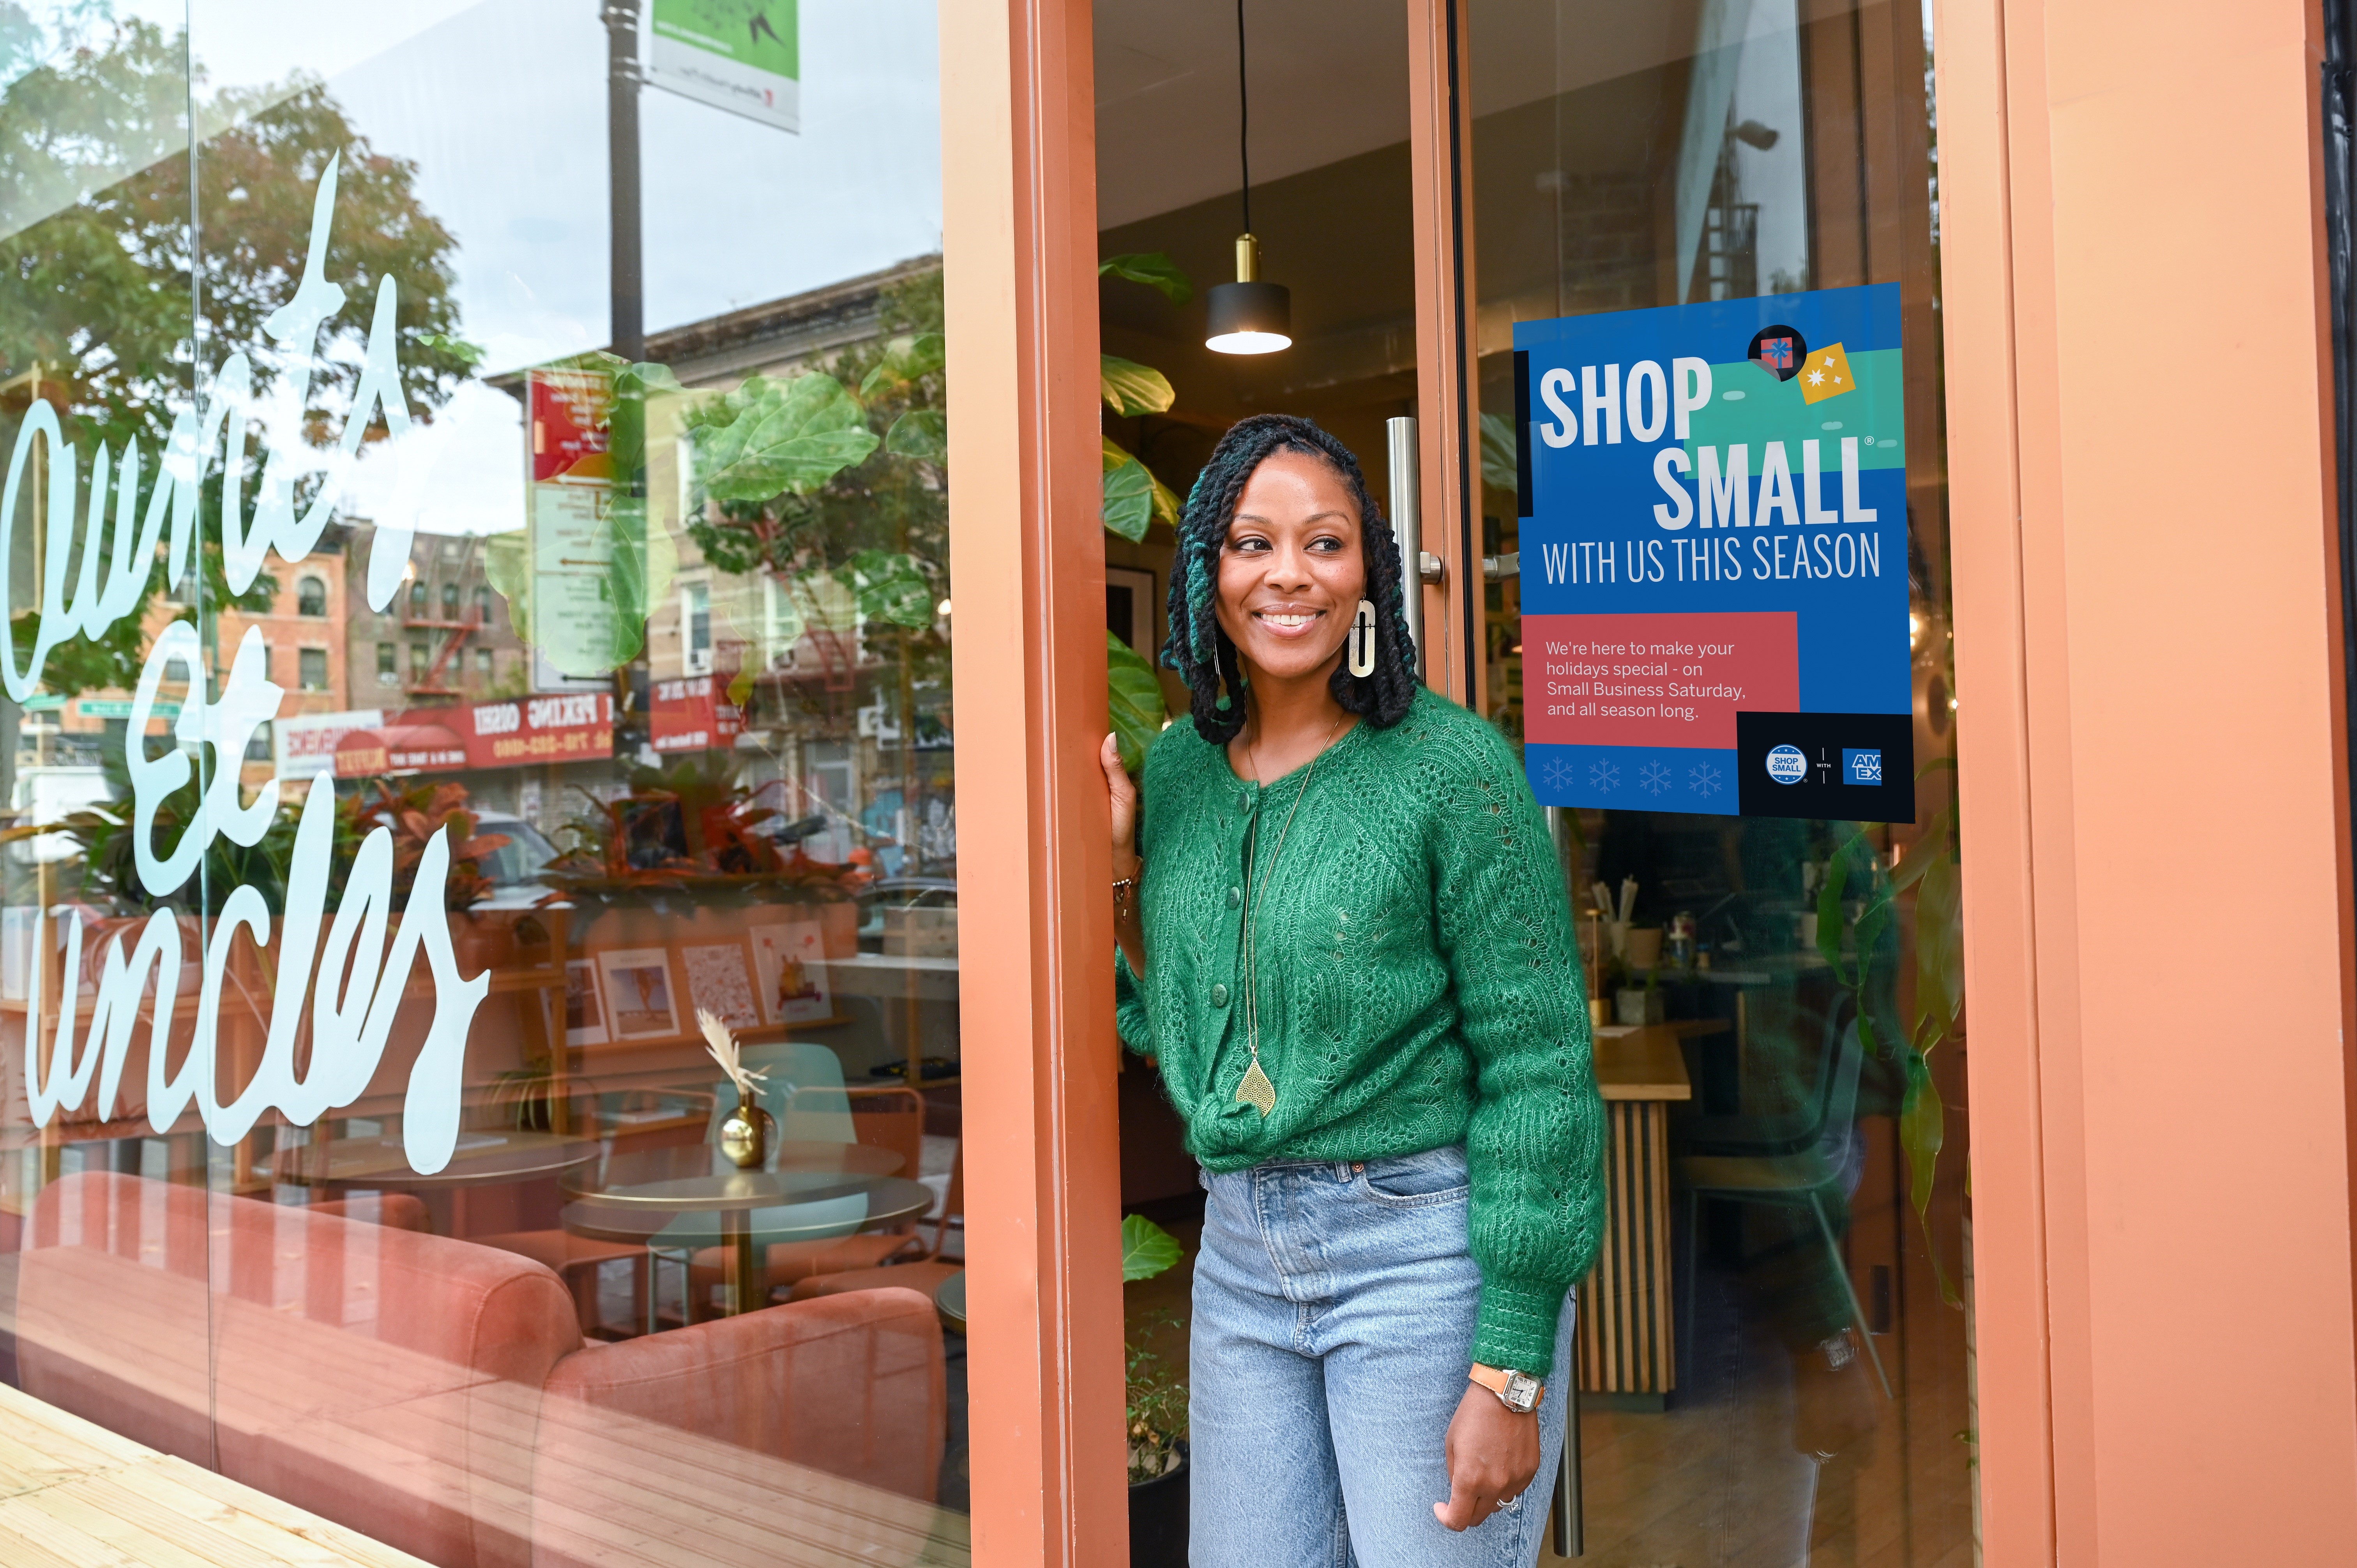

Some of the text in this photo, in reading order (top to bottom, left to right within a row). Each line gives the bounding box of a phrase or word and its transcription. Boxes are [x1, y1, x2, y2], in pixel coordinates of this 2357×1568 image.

[1540, 357, 1712, 449] SHOP
[1543, 532, 1880, 584] WITH US THIS SEASON
[1546, 641, 1735, 658] We're here to make your
[1546, 662, 1609, 678] holidays
[1613, 662, 1668, 678] special
[1682, 664, 1702, 676] on
[1547, 682, 1746, 701] Small Business Saturday,
[1548, 703, 1699, 721] and all season long.
